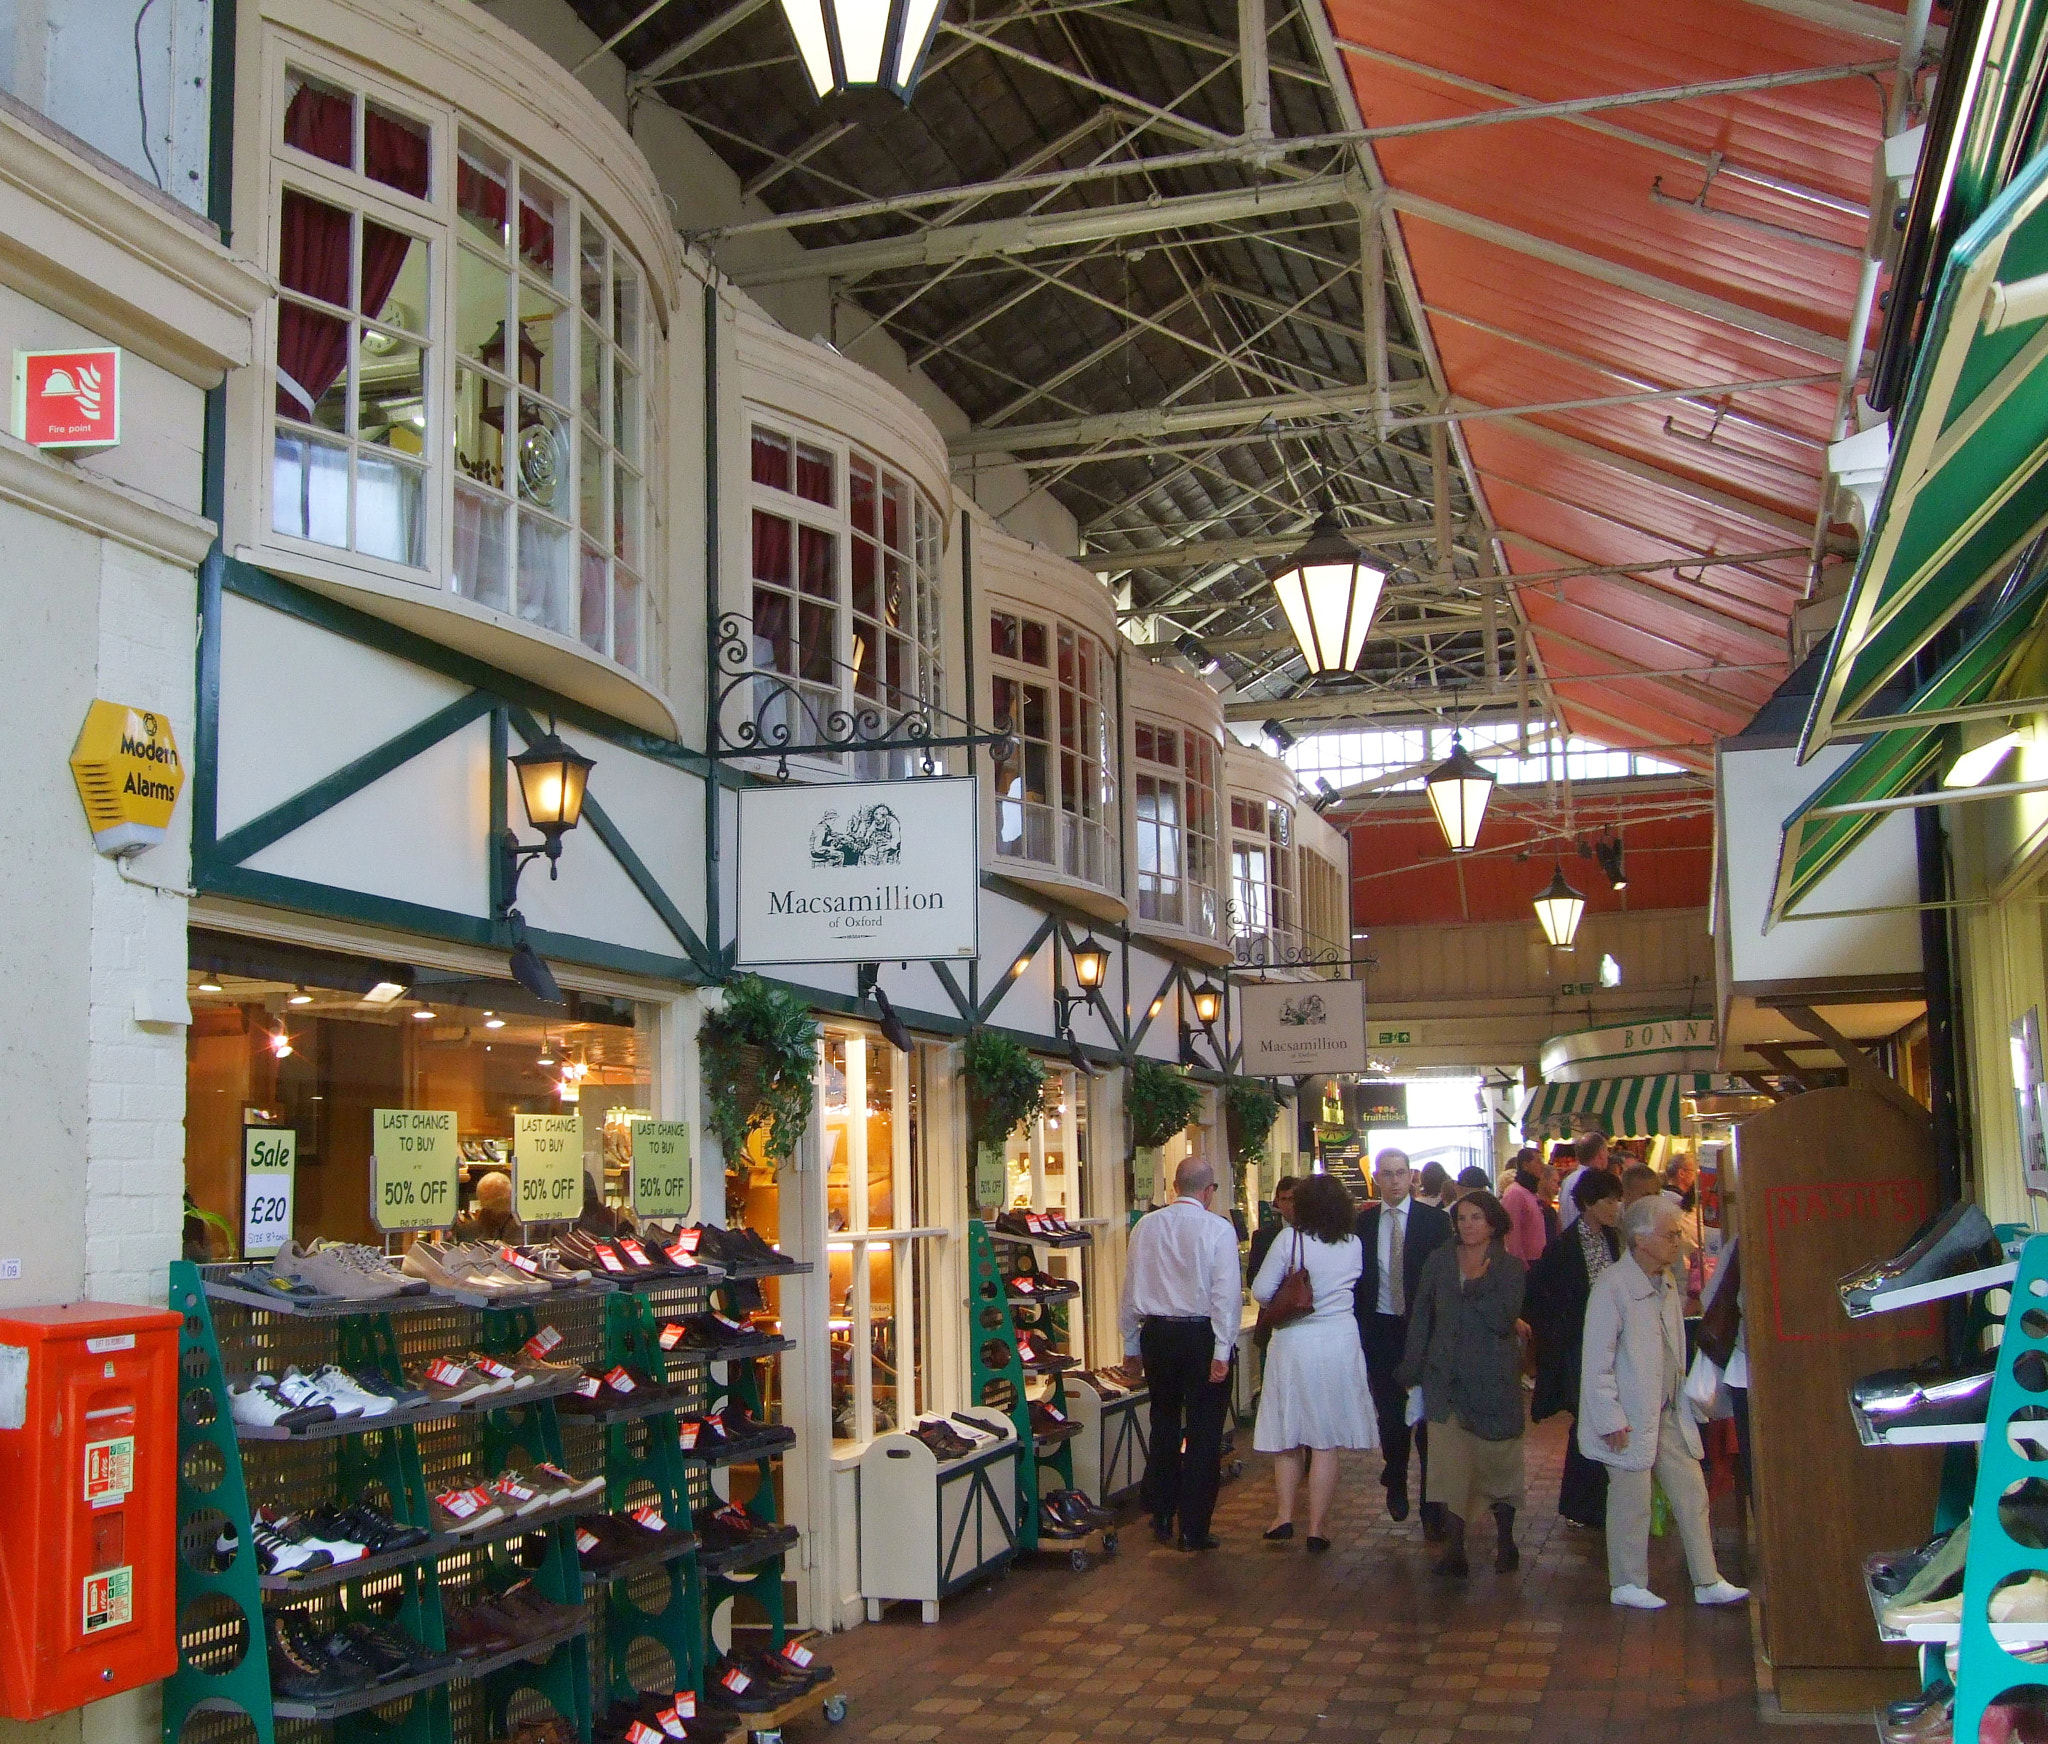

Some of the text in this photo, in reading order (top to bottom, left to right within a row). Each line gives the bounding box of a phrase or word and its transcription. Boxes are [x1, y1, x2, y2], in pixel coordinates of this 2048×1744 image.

[48, 424, 91, 434] Fire point
[120, 733, 178, 766] Modern
[123, 771, 175, 802] Alarms
[767, 886, 945, 915] Macsamillion
[828, 915, 883, 928] of Oxford
[1260, 1037, 1348, 1053] Macsamillion
[383, 1114, 449, 1130] LAST CHANCE
[1363, 1112, 1406, 1122] fruitsticks
[522, 1118, 576, 1133] LAST CHANCE
[637, 1123, 684, 1137] LAST CHANCE
[399, 1137, 435, 1151] TO BUY
[535, 1139, 565, 1153] TO BUY
[649, 1142, 674, 1154] TO BUY
[251, 1139, 290, 1167] Sale
[385, 1181, 447, 1206] 50% OFF
[523, 1178, 574, 1201] 50% OFF
[640, 1178, 684, 1197] 50% OFF
[251, 1197, 287, 1224] £20
[1777, 1186, 1915, 1229] NASH'S
[247, 1233, 264, 1244] SIZE
